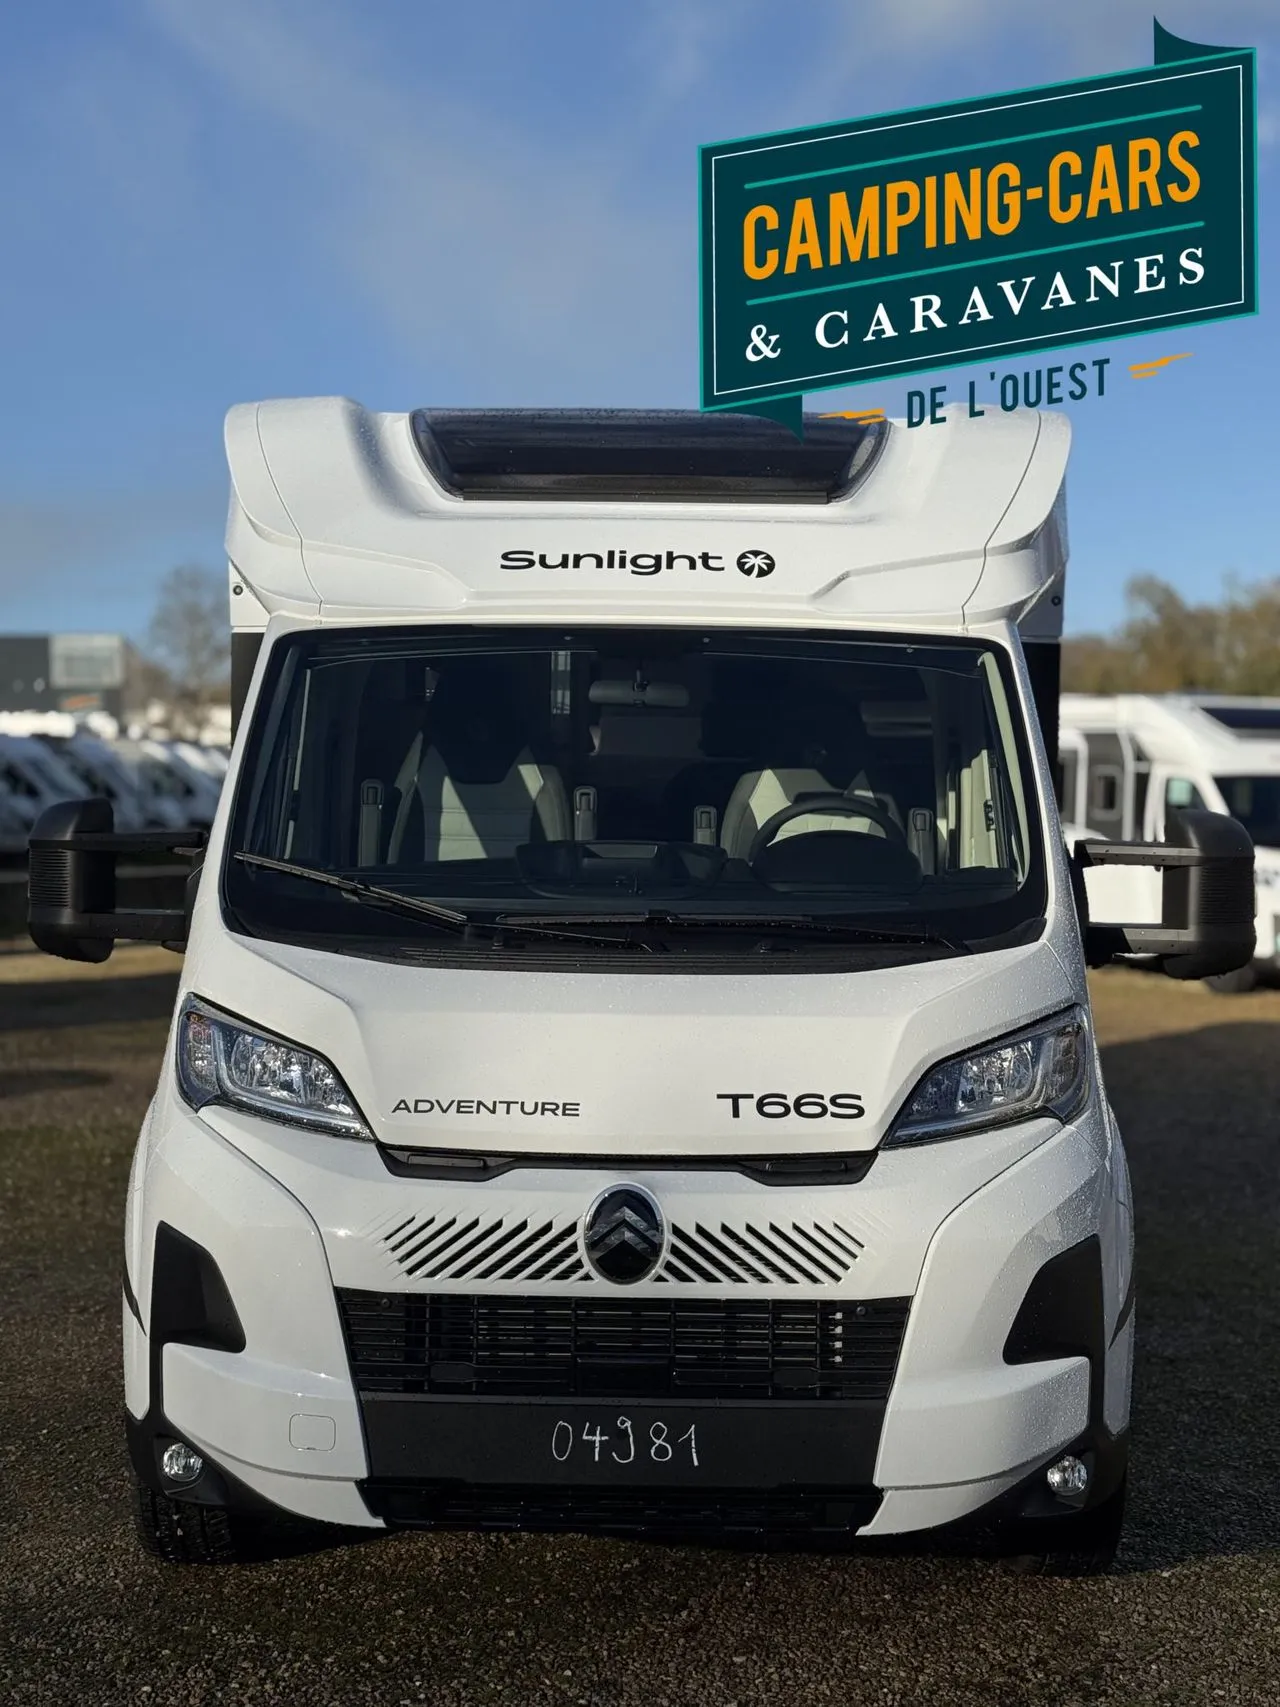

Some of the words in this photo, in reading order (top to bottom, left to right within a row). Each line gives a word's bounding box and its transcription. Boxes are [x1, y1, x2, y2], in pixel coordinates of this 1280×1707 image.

[500, 549, 725, 575] Sunlight
[391, 1098, 581, 1117] ADVENTURE
[716, 1092, 866, 1119] T66S
[551, 1416, 700, 1467] 04981
